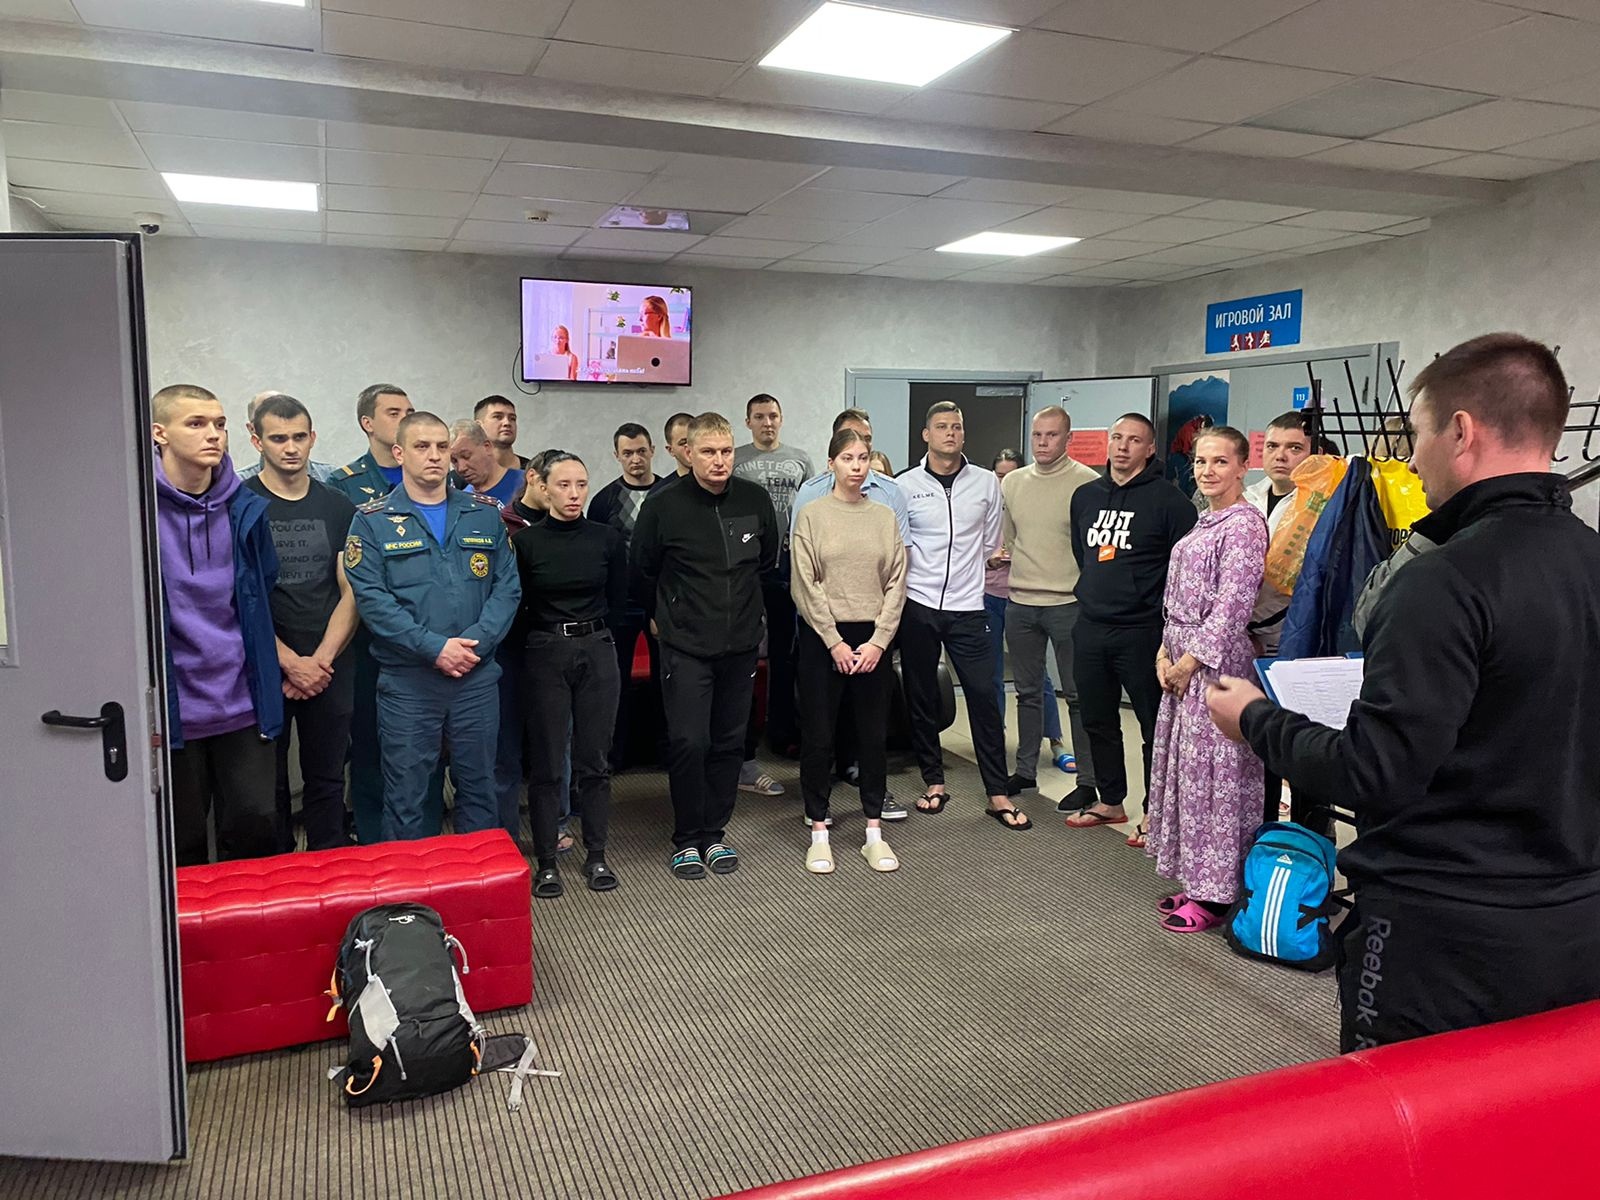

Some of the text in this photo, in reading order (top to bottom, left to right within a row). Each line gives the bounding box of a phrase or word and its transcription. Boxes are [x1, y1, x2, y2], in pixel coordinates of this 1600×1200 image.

[1215, 302, 1292, 329] ИГРОВОЙ ЗАЛ
[766, 477, 796, 488] TEAM
[912, 491, 935, 499] KELME
[270, 523, 316, 533] YOU CAN
[1092, 509, 1135, 530] JUST
[1087, 527, 1132, 550] DO IT.
[1356, 916, 1391, 1026] Reebok
